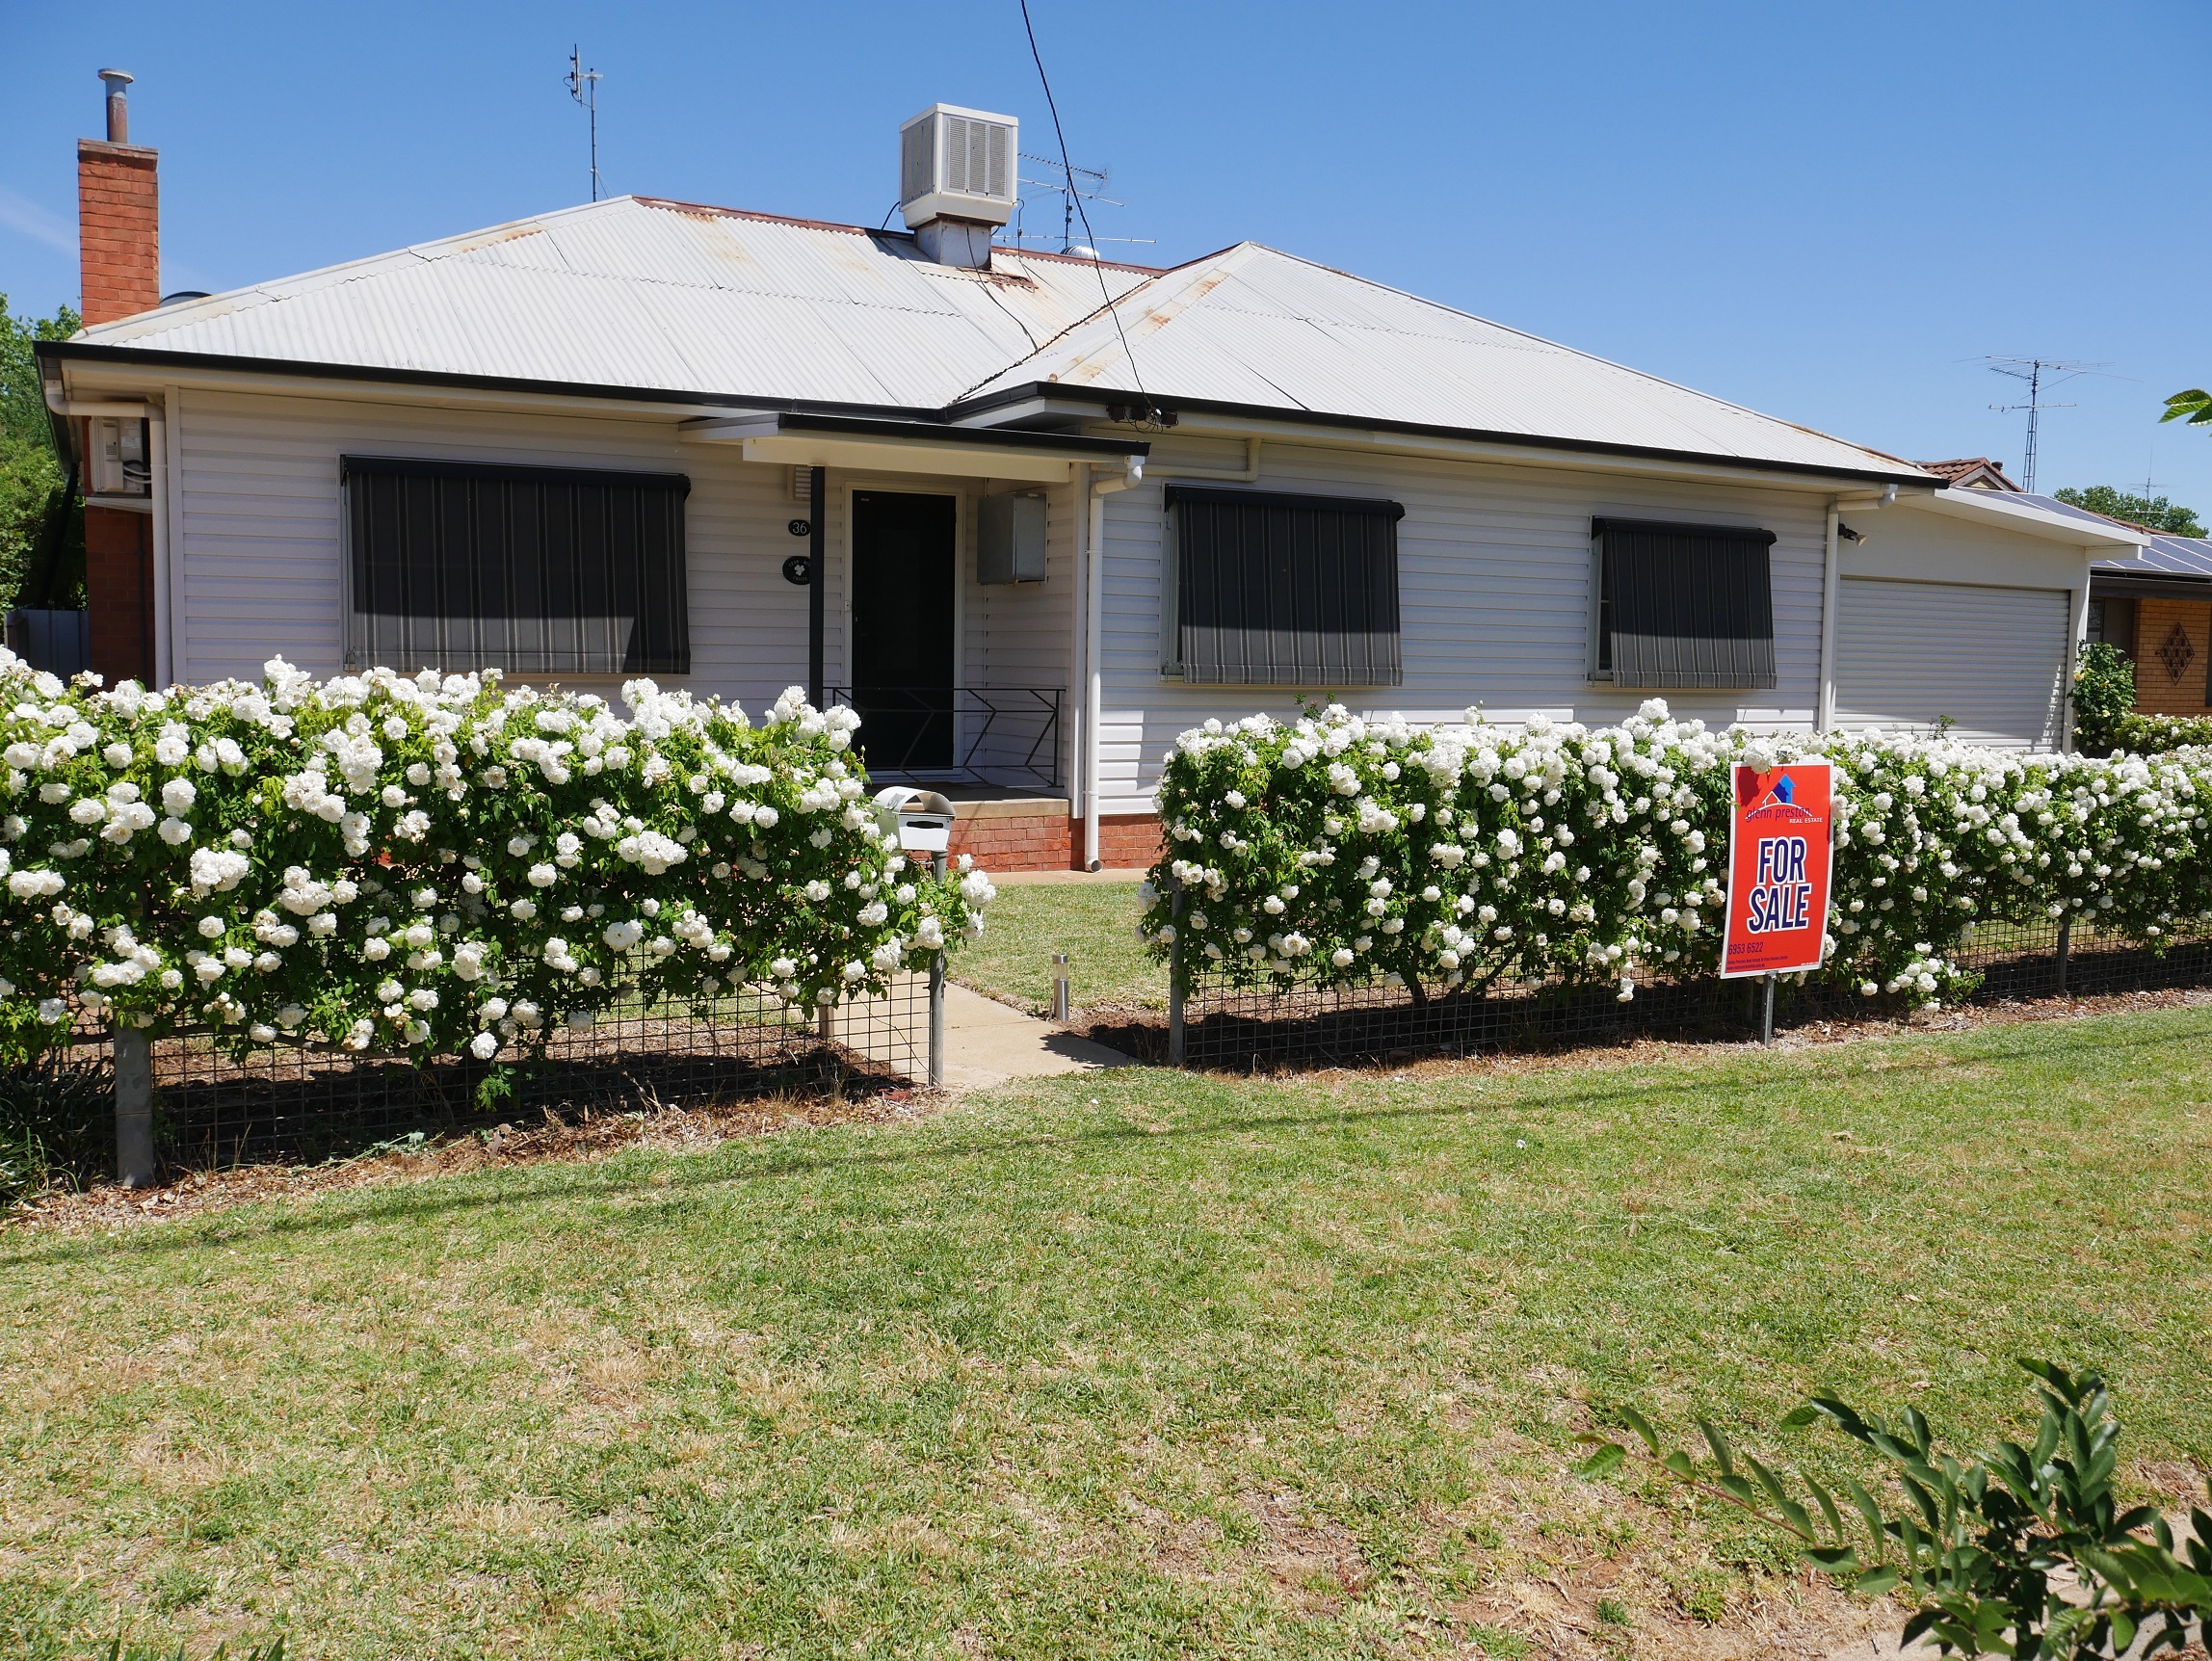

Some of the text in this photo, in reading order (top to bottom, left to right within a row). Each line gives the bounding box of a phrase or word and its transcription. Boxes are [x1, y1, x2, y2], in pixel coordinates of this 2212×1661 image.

[792, 521, 807, 534] 36
[1746, 806, 1810, 823] glenn preston
[1757, 837, 1806, 884] FOR
[1748, 884, 1811, 933] SALE
[1728, 941, 1764, 955] 6953 6522
